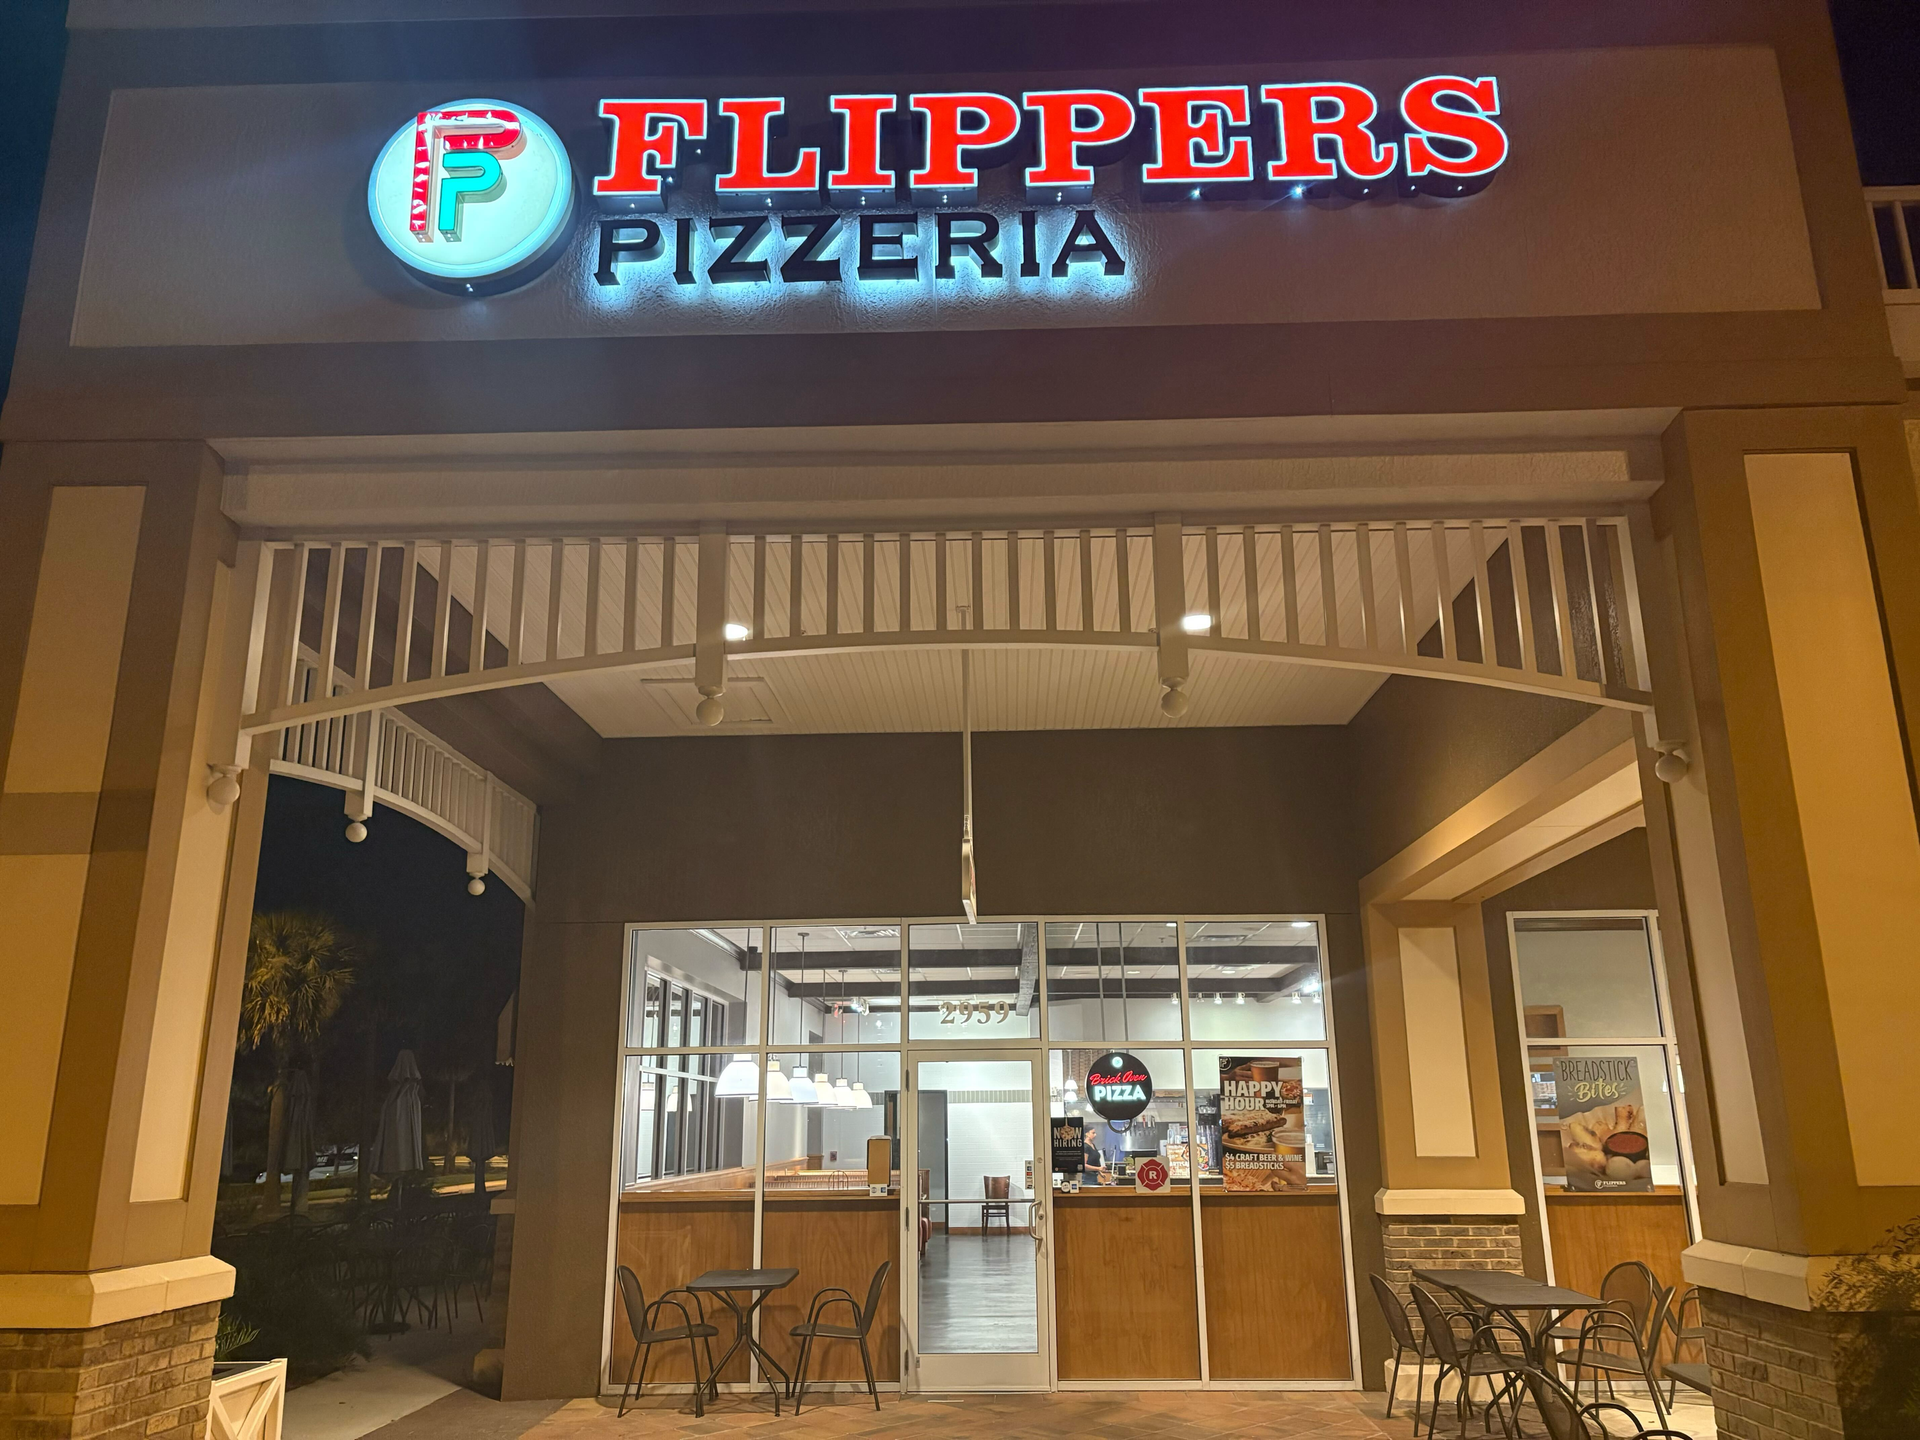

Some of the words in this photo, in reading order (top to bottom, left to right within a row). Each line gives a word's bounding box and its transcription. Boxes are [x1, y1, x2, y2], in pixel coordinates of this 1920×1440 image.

[592, 74, 1509, 197] FLIPPERS
[592, 208, 1126, 286] PIZZERIA
[940, 1000, 1010, 1025] 2959
[1089, 1072, 1122, 1086] Brick
[1122, 1070, 1148, 1083] Oven
[1560, 1060, 1633, 1082] BREADSTICK
[1093, 1084, 1147, 1102] PIZZA
[1223, 1080, 1284, 1097] HAPPY
[1574, 1077, 1619, 1103] Bites
[1224, 1097, 1266, 1111] HOUR
[1053, 1139, 1083, 1148] HIRING
[1225, 1152, 1235, 1162] $4
[1236, 1154, 1258, 1162] CRAFT
[1259, 1154, 1277, 1162] BEER
[1278, 1154, 1285, 1162] &
[1285, 1154, 1303, 1162] WINE
[1225, 1161, 1235, 1170] $5
[1236, 1162, 1285, 1170] BREADSTICKS
[1148, 1171, 1157, 1180] R
